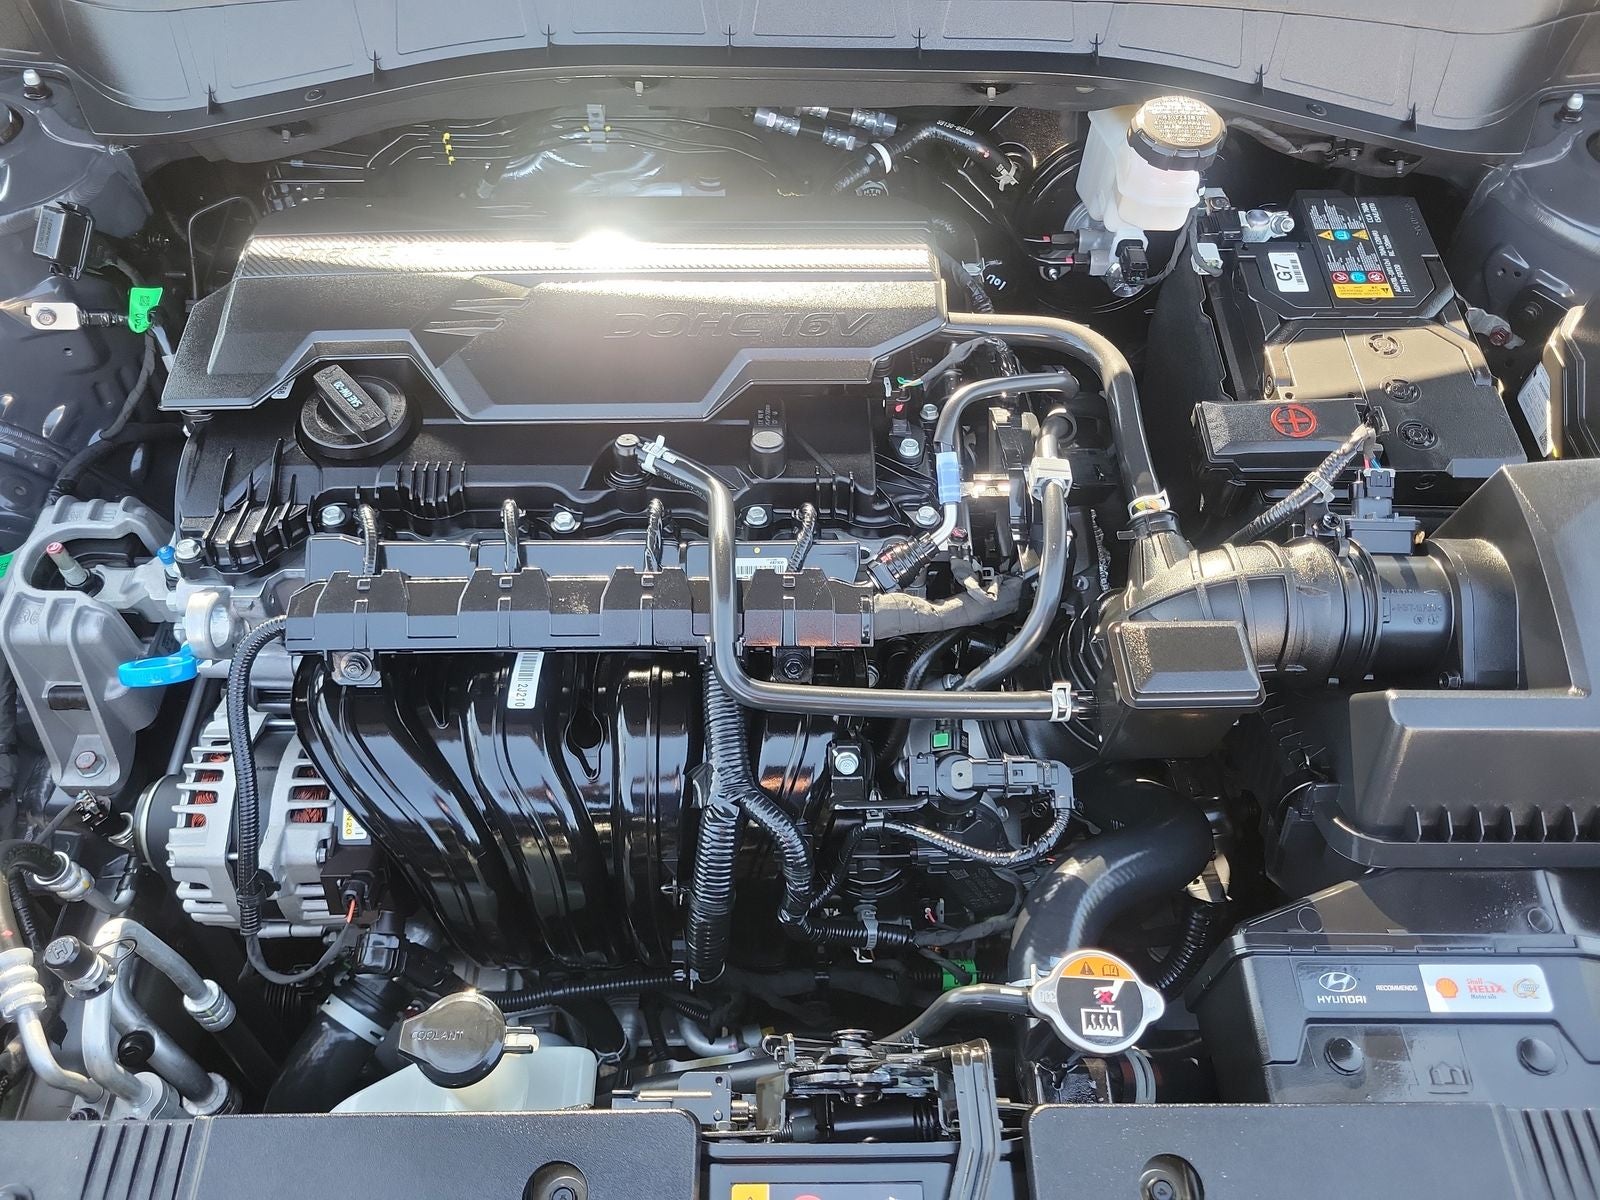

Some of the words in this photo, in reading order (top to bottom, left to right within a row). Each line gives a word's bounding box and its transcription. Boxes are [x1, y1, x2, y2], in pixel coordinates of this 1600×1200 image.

[1273, 262, 1293, 281] G7
[603, 312, 770, 338] DOHC
[781, 312, 877, 338] 16V
[333, 380, 353, 399] 0W-20
[346, 394, 363, 408] SAE
[514, 683, 529, 707] 2J210
[1375, 984, 1418, 992] RECOMMENDS
[1467, 985, 1505, 993] HELIX
[1316, 995, 1367, 1004] HYUNDAI
[411, 1030, 464, 1041] COOLANT
